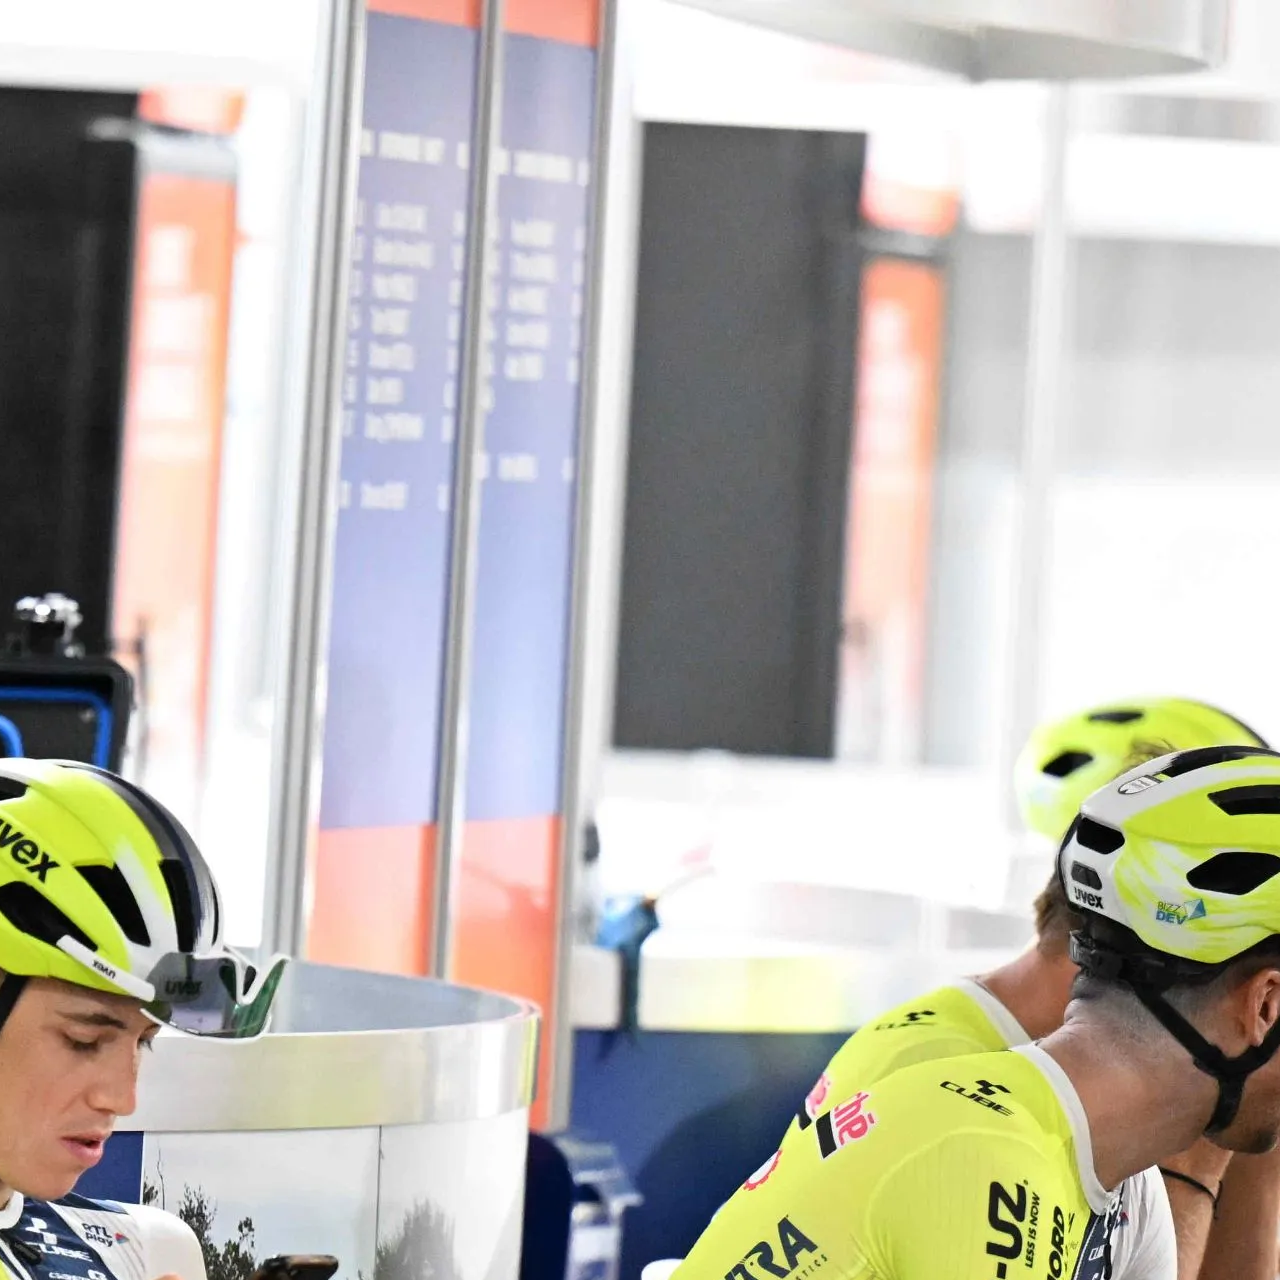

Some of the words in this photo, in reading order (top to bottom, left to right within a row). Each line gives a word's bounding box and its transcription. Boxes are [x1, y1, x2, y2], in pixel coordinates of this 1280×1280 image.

[1073, 886, 1105, 910] uvex
[1155, 910, 1189, 925] DEV
[90, 958, 118, 980] uvex
[939, 1080, 1016, 1118] CUBE
[1030, 1191, 1041, 1223] NOW
[81, 1222, 113, 1239] RTL
[1027, 1226, 1039, 1240] IS
[1024, 1240, 1036, 1270] LESS
